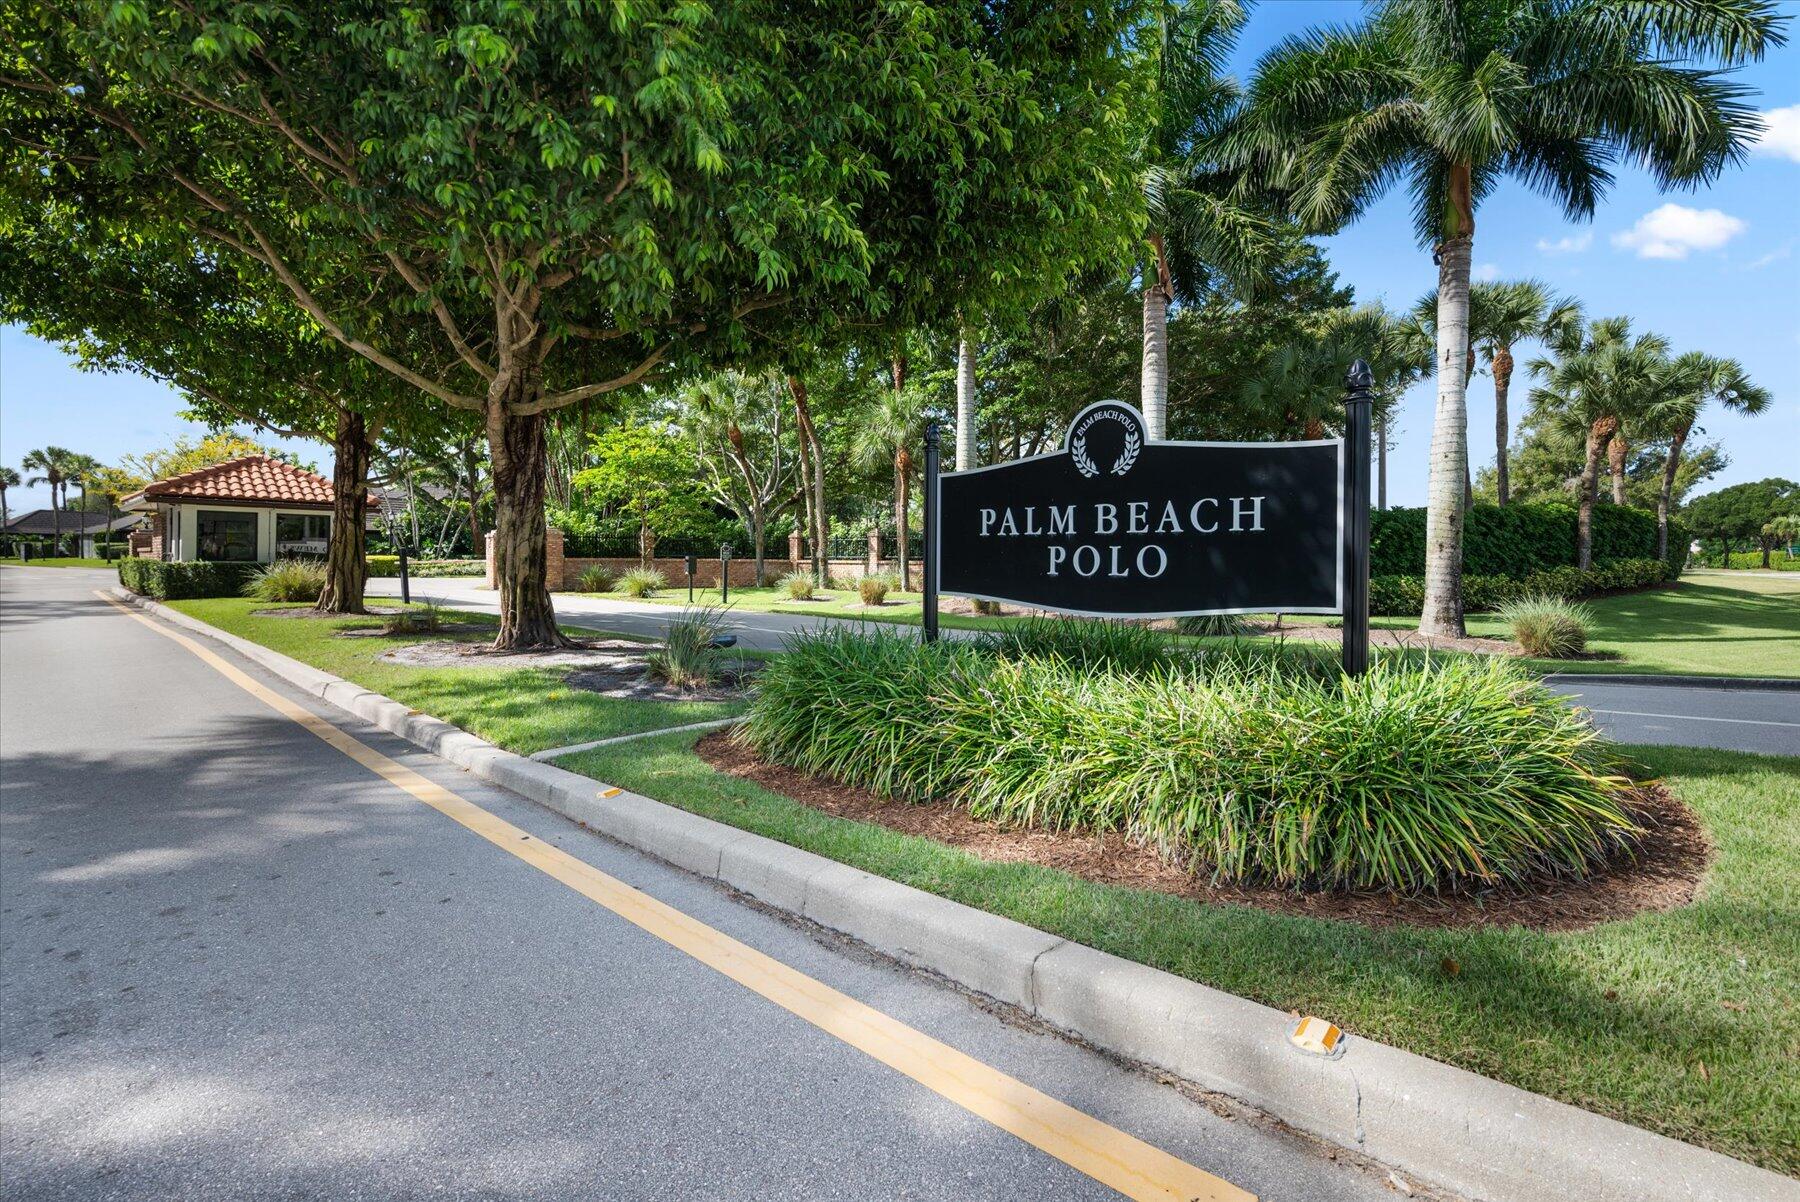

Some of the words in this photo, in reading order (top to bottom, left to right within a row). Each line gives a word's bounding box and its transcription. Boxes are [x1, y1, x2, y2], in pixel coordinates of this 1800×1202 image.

[1077, 416, 1095, 437] PALM
[1093, 409, 1119, 421] BEACH
[1117, 412, 1136, 432] POLO
[979, 504, 1077, 536] PALM
[1094, 496, 1266, 534] BEACH
[1046, 544, 1168, 578] POLO
